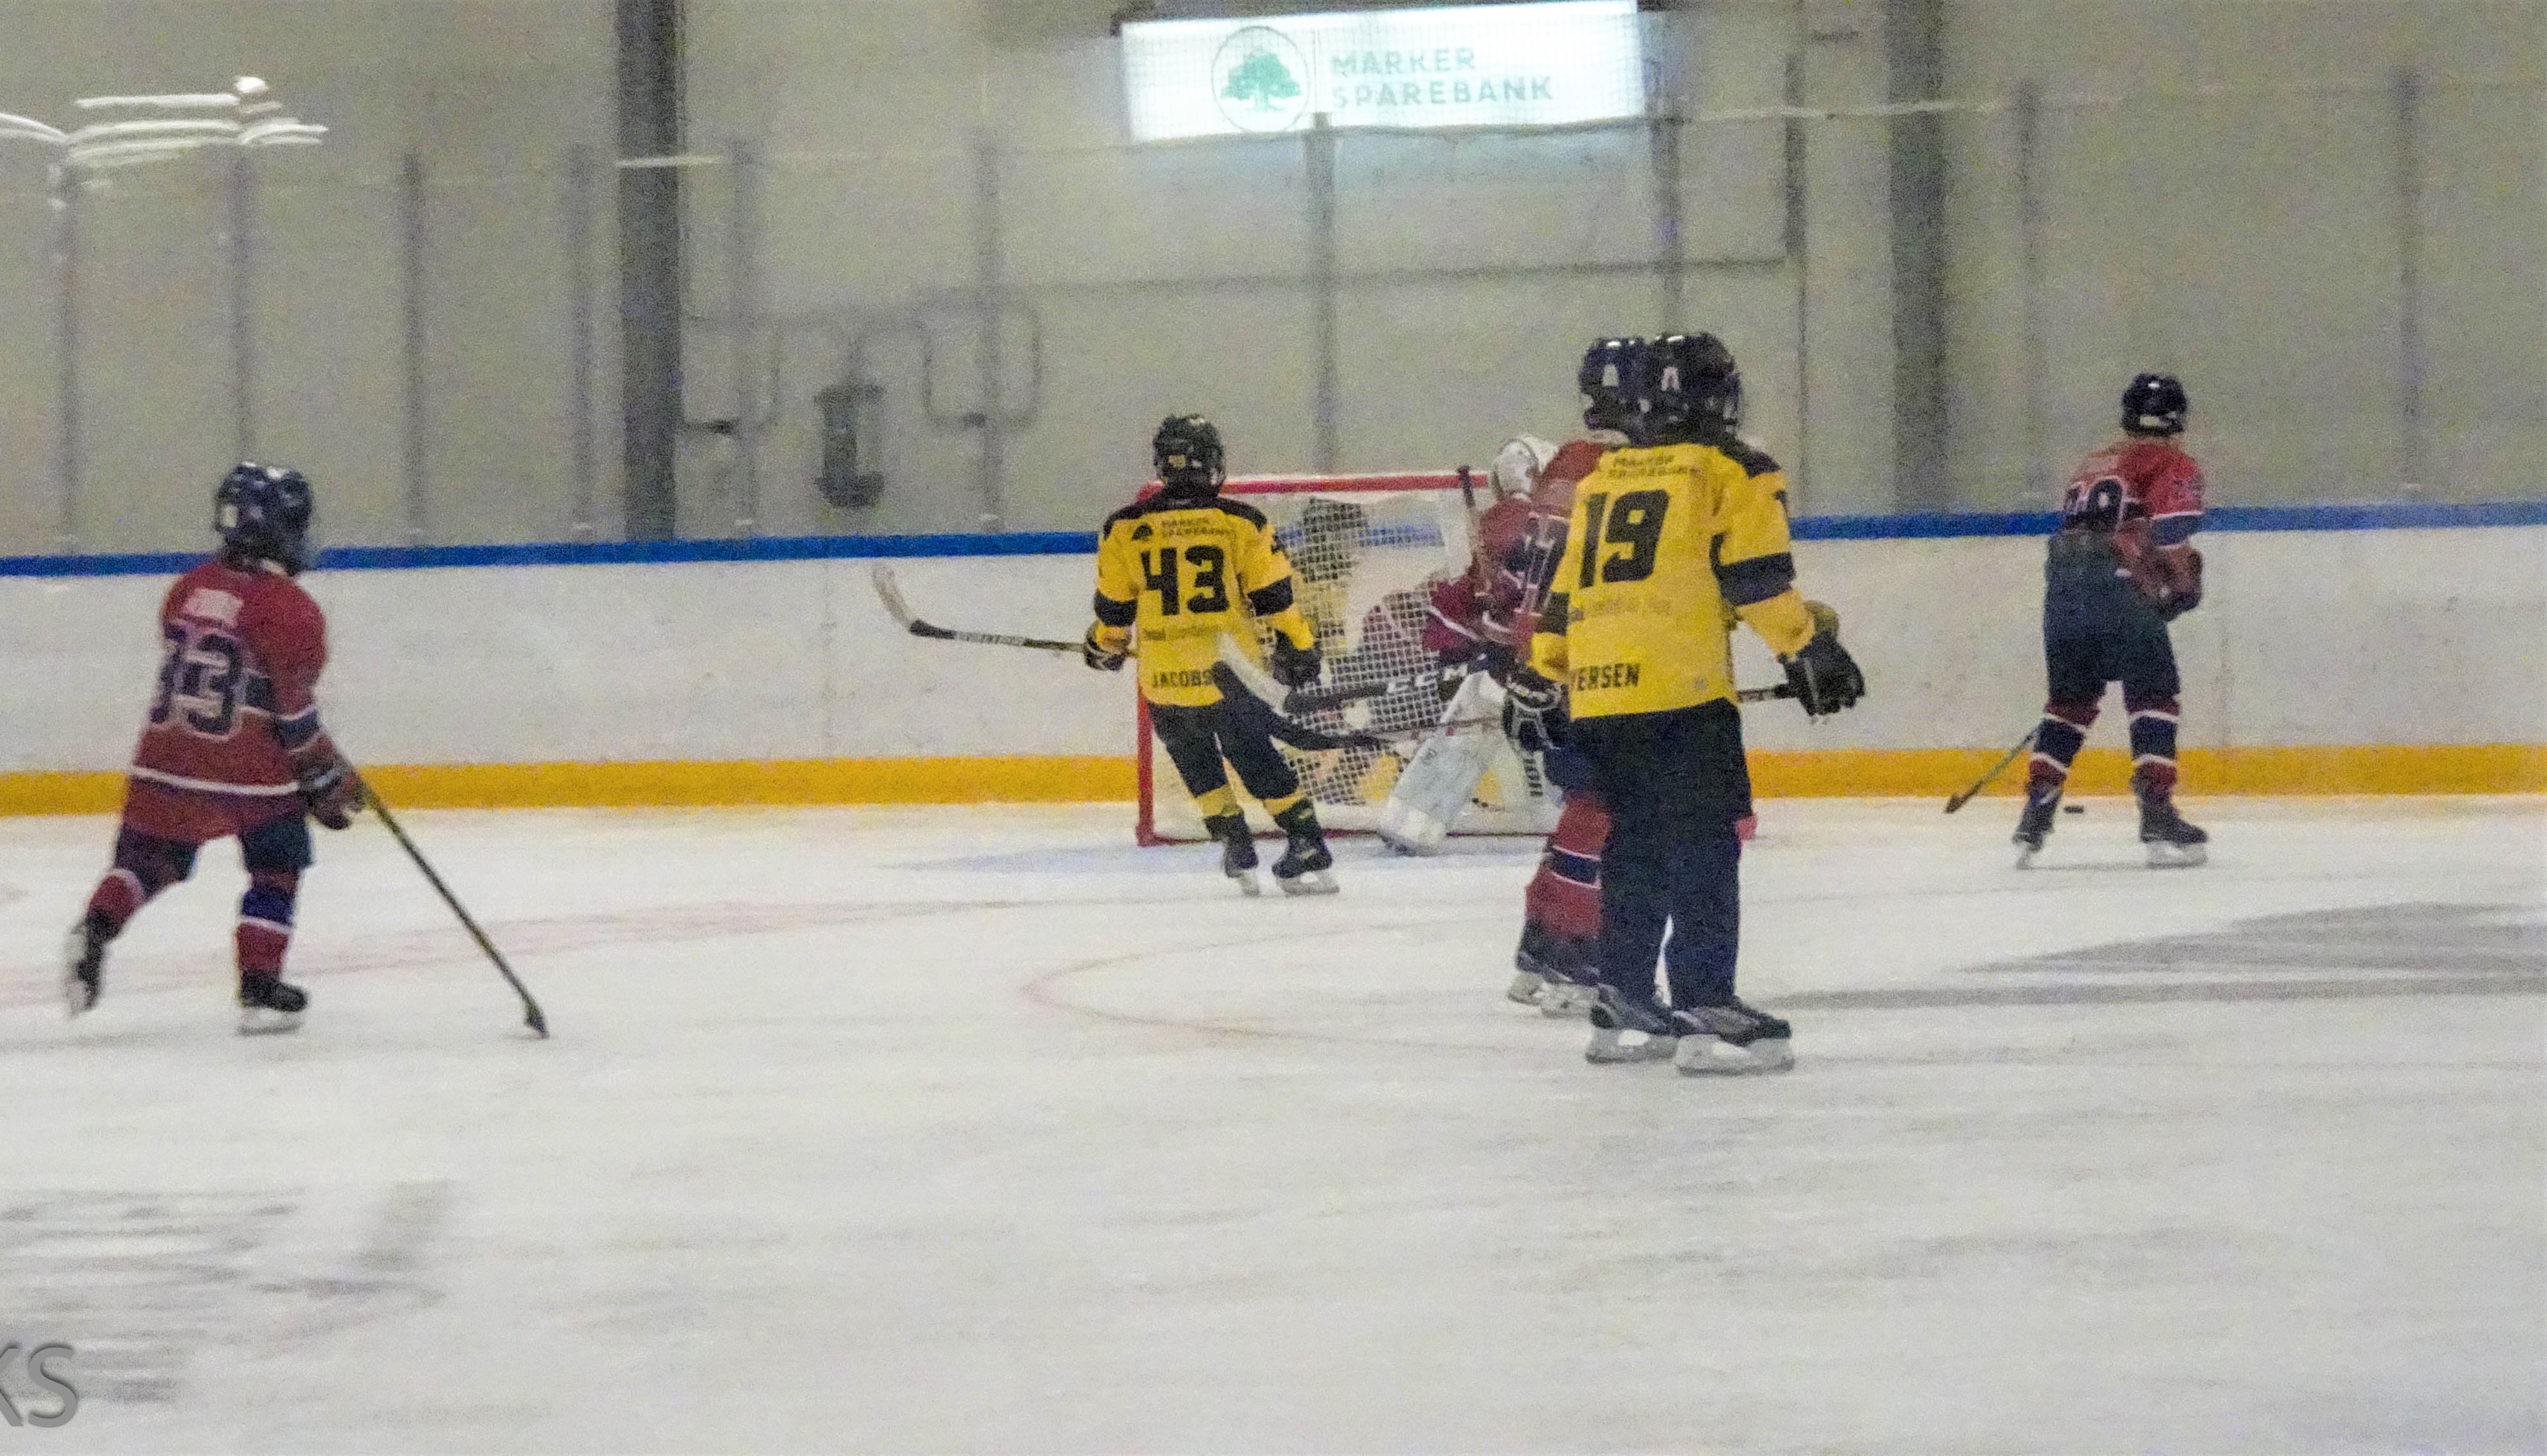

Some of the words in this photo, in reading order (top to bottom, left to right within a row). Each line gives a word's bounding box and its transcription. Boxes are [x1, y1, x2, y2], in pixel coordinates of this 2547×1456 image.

[1330, 47, 1476, 76] MARKER
[1331, 75, 1553, 109] SPAREBANK
[1578, 489, 1671, 589] 19
[1140, 544, 1230, 616] 43
